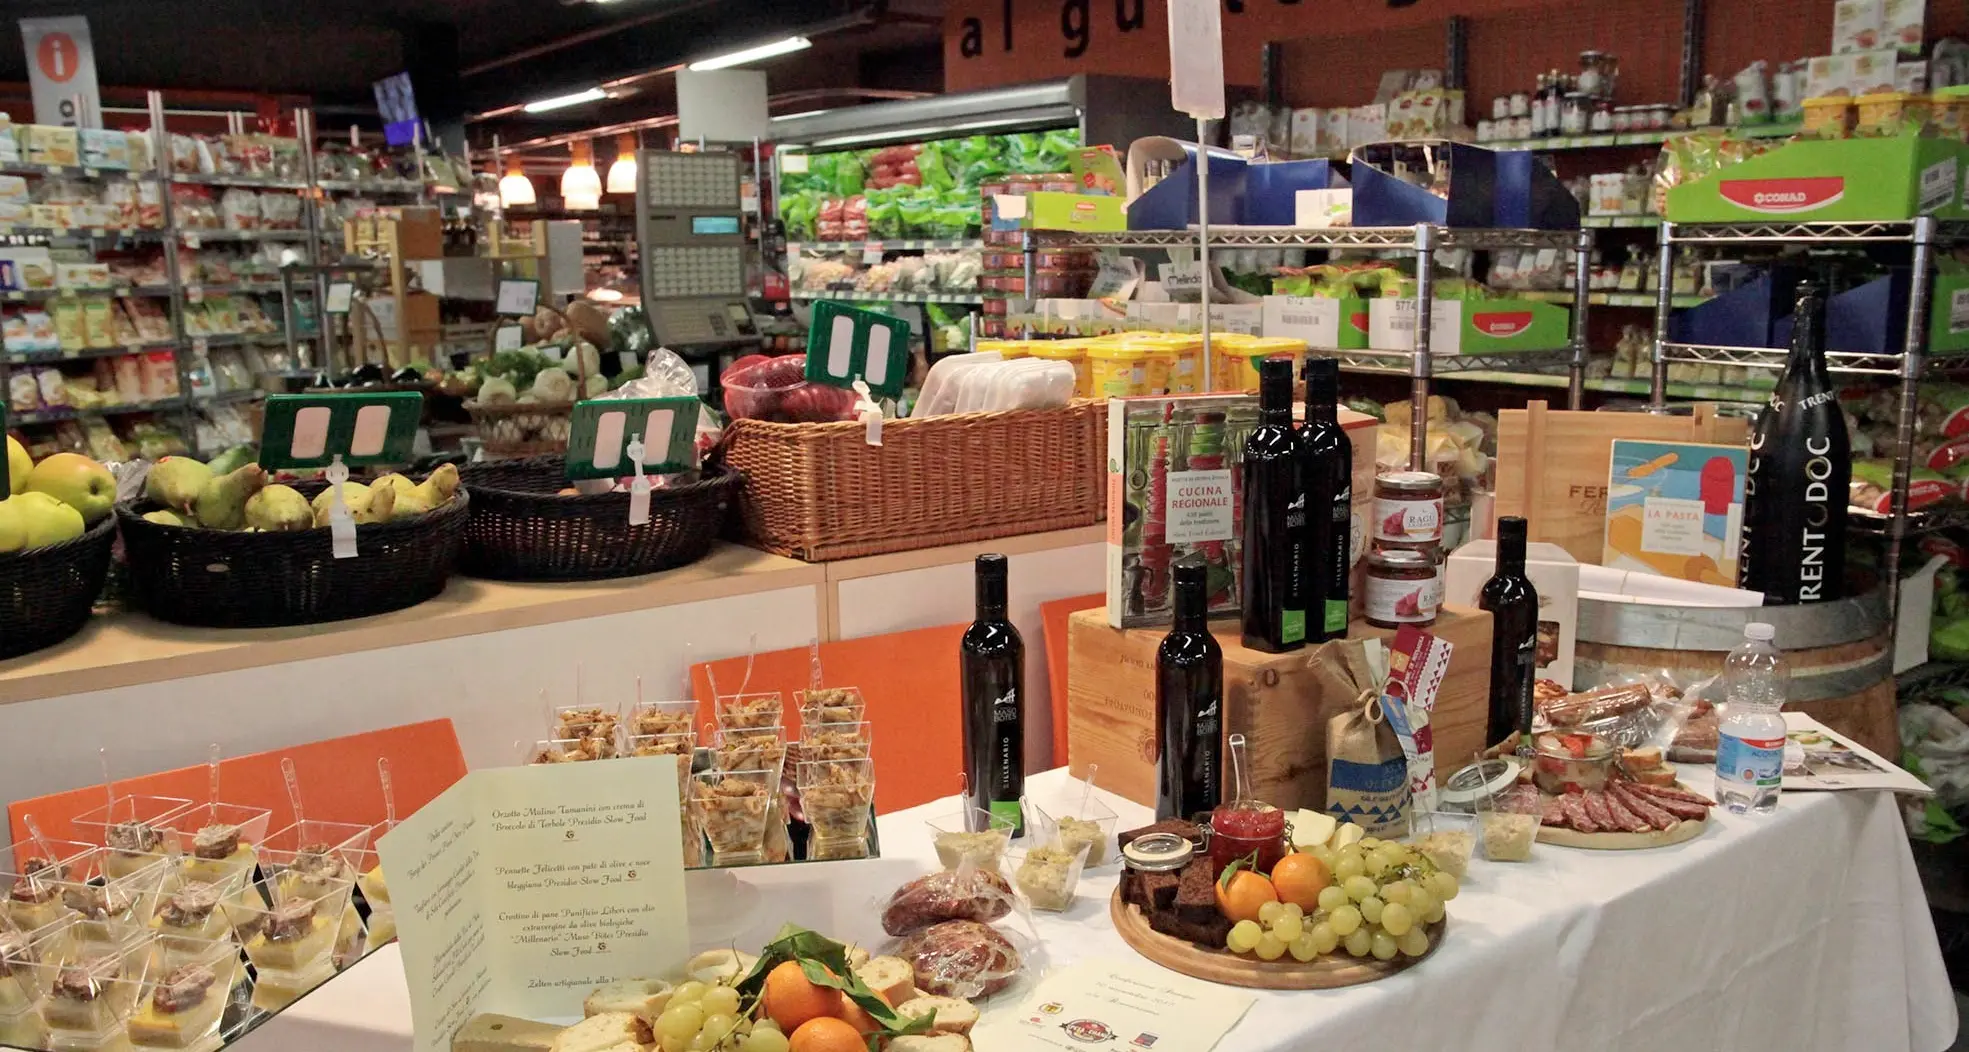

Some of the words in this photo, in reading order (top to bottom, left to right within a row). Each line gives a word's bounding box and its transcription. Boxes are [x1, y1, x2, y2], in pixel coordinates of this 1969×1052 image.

[1766, 192, 1806, 203] CONAD
[1178, 486, 1223, 497] CUCINA
[1569, 485, 1608, 499] FER
[1171, 496, 1228, 509] REGIONALE
[1647, 510, 1661, 519] LA
[1665, 510, 1700, 522] PASTA
[1800, 437, 1832, 604] RENTODOC
[523, 808, 555, 817] Molino
[637, 800, 644, 808] di
[528, 821, 535, 829] di
[568, 816, 601, 827] Presidio
[604, 814, 624, 824] Slow
[626, 812, 646, 824] Food
[600, 860, 607, 869] di
[609, 860, 626, 868] olive
[544, 877, 577, 888] Presidio
[579, 875, 599, 886] Slow
[601, 874, 622, 885] Food
[642, 904, 655, 912] olio
[569, 921, 577, 929] da
[580, 920, 596, 928] olive
[550, 947, 570, 957] Slow
[571, 946, 592, 957] Food
[595, 976, 609, 984] alla
